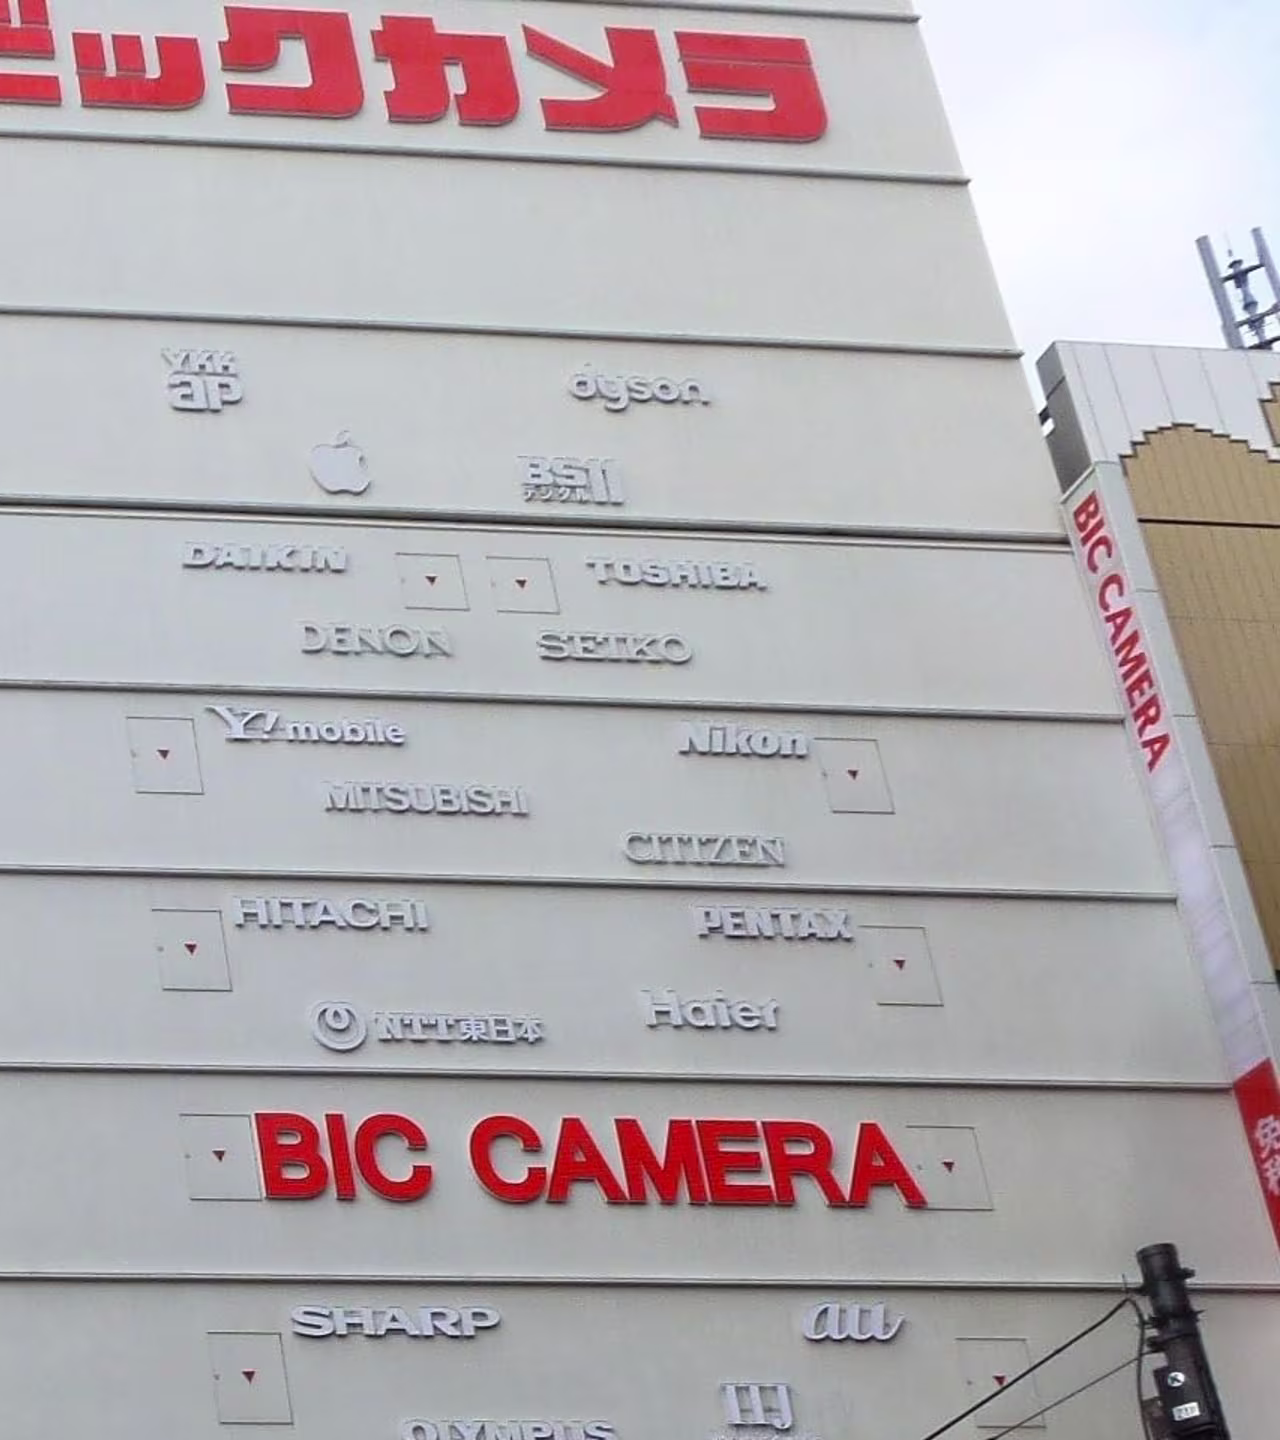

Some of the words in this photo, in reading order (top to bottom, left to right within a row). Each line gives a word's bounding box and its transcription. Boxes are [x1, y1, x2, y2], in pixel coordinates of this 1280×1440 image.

[161, 347, 238, 374] YKK
[168, 372, 243, 411] ap
[567, 362, 711, 412] dyson
[182, 540, 349, 574] DAIKIN
[585, 556, 769, 591] TOSHIBA
[300, 621, 454, 657] DENON
[537, 630, 693, 664] SEIKO
[1073, 485, 1117, 577] BIC
[1096, 570, 1175, 774] CAMERA
[677, 720, 809, 759] Nikon
[324, 781, 529, 817] MITSUBISHI
[622, 831, 786, 867] CITIZEN
[232, 896, 431, 933] HITACHI
[695, 906, 854, 942] PENTAX
[643, 989, 781, 1032] Haier
[254, 1112, 433, 1201] BIC
[469, 1115, 927, 1209] CAMERA
[291, 1304, 501, 1339] SHARP
[802, 1301, 907, 1343] au
[720, 1383, 793, 1429] IIJ
